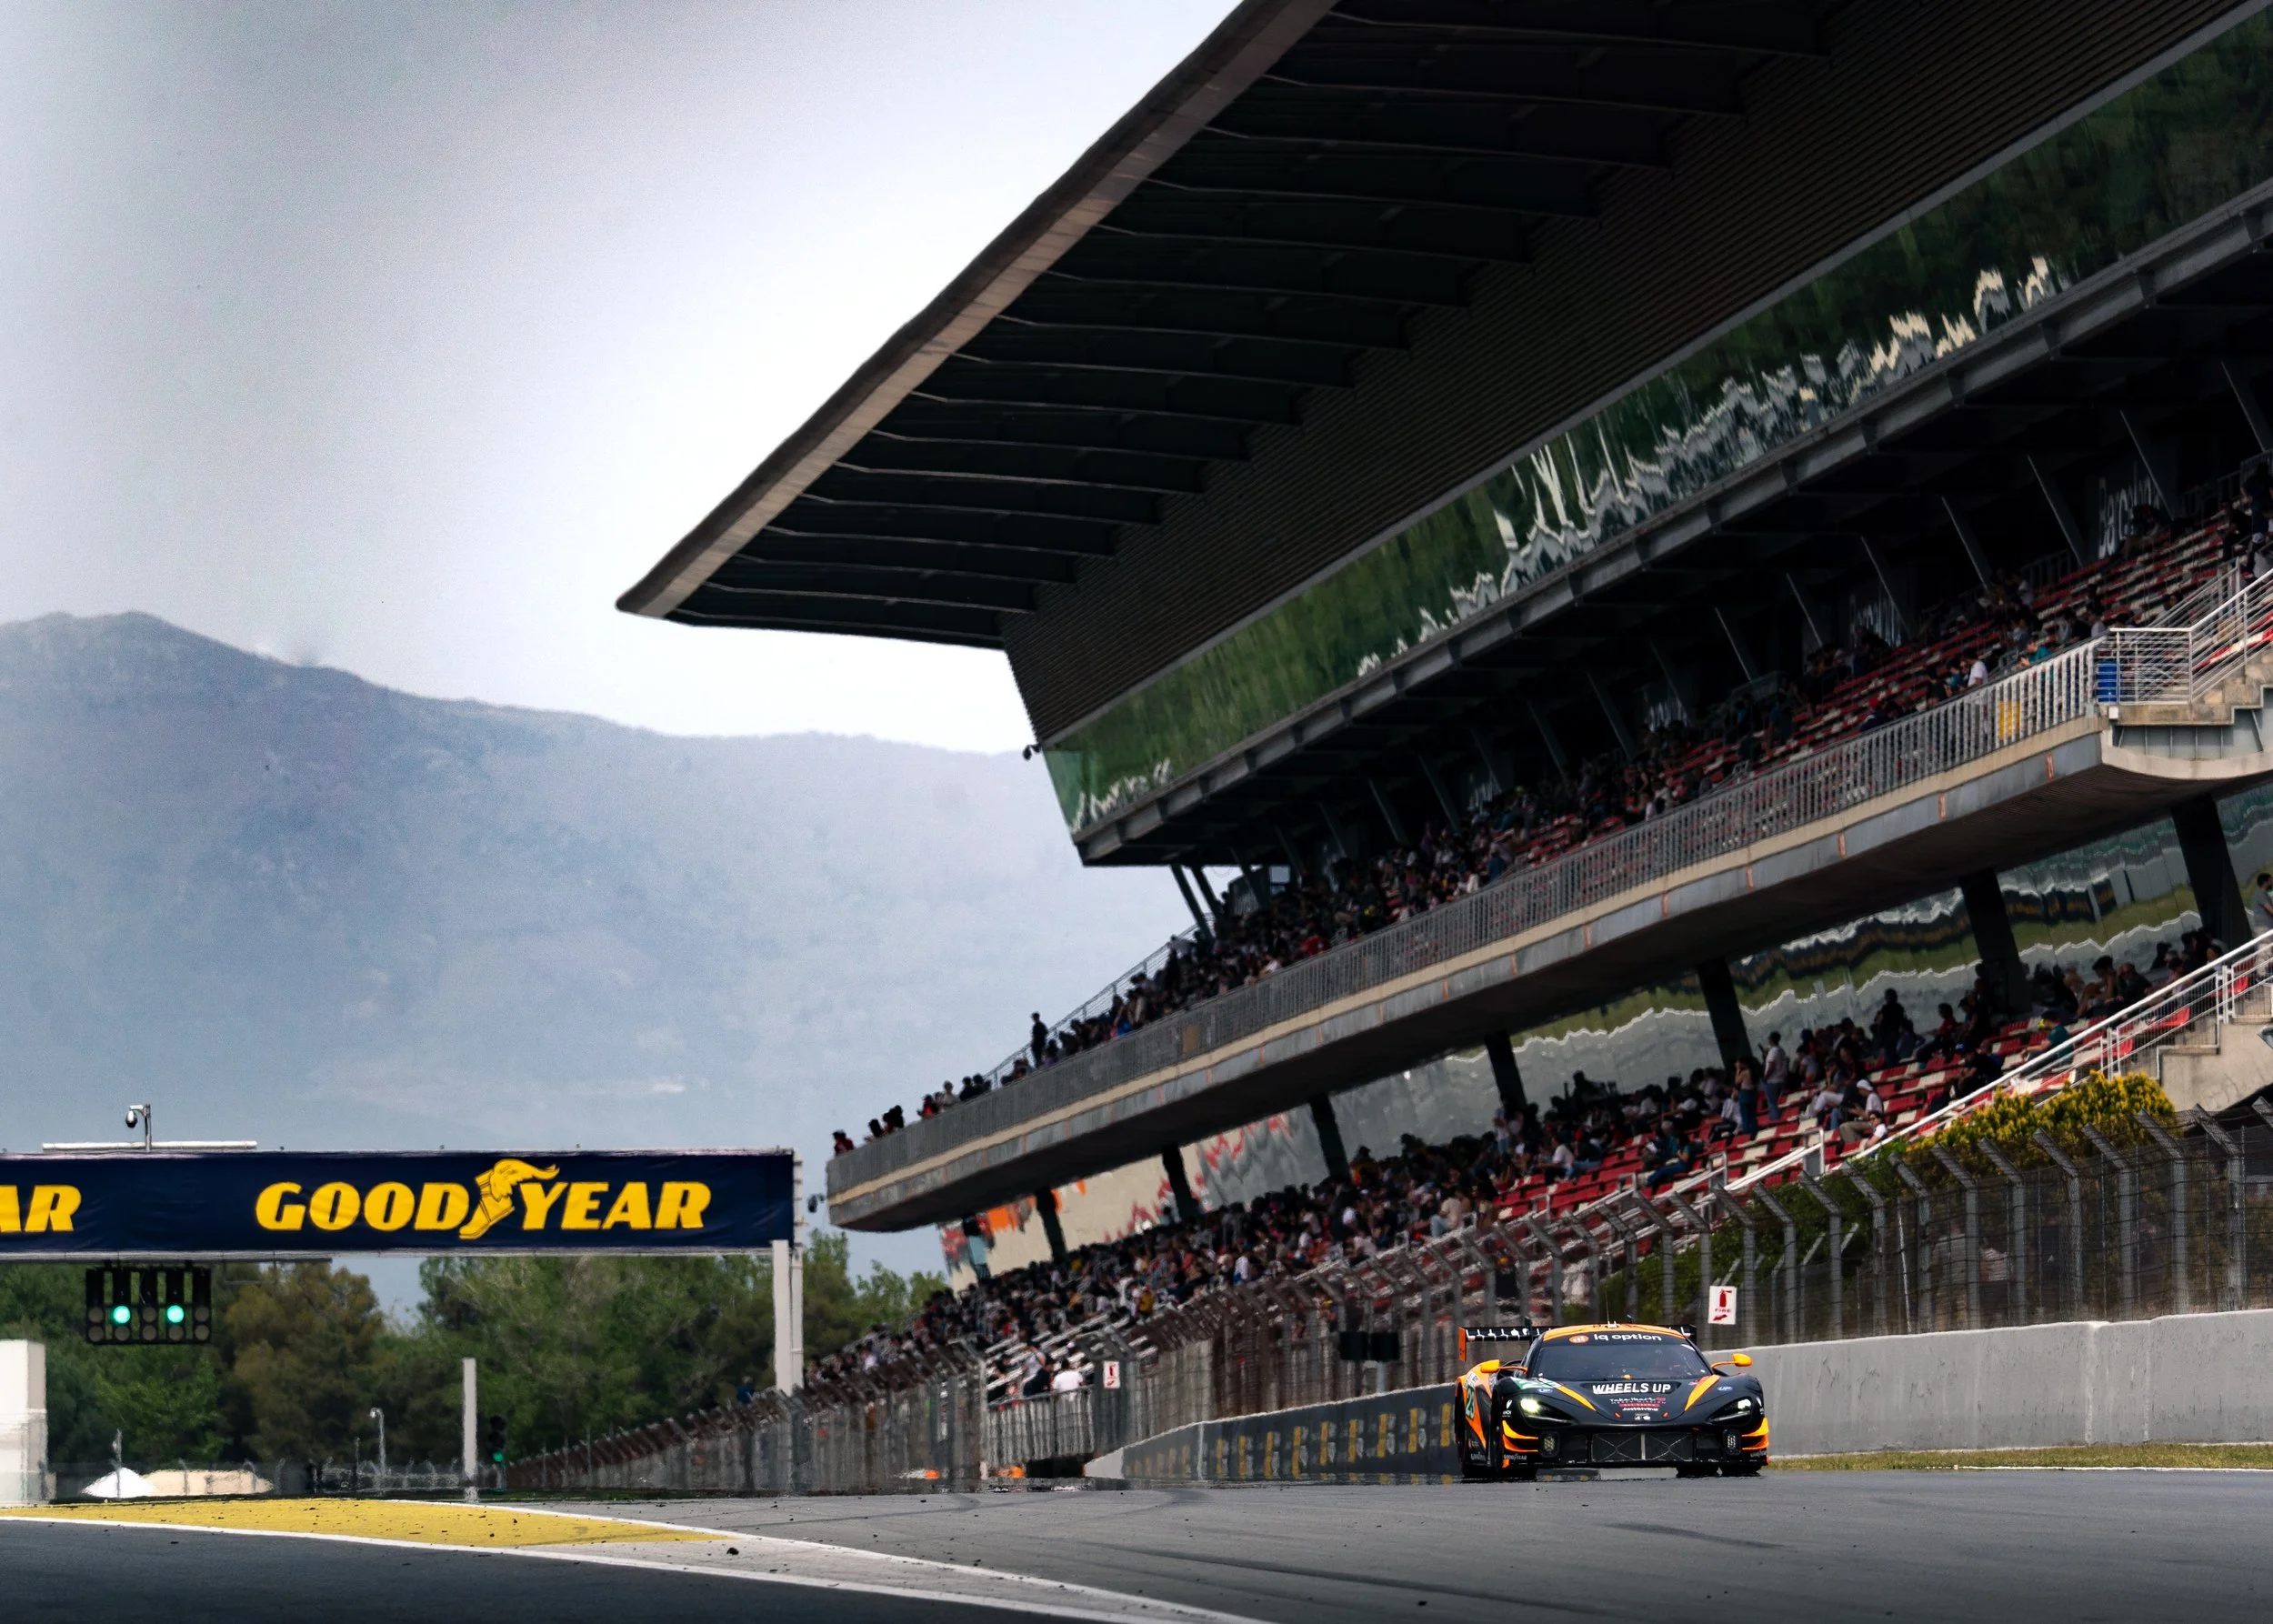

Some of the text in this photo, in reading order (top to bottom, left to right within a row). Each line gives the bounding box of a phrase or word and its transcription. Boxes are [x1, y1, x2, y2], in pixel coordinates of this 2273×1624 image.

[1611, 1333, 1662, 1341] option
[1592, 1382, 1671, 1395] WHEELS UP
